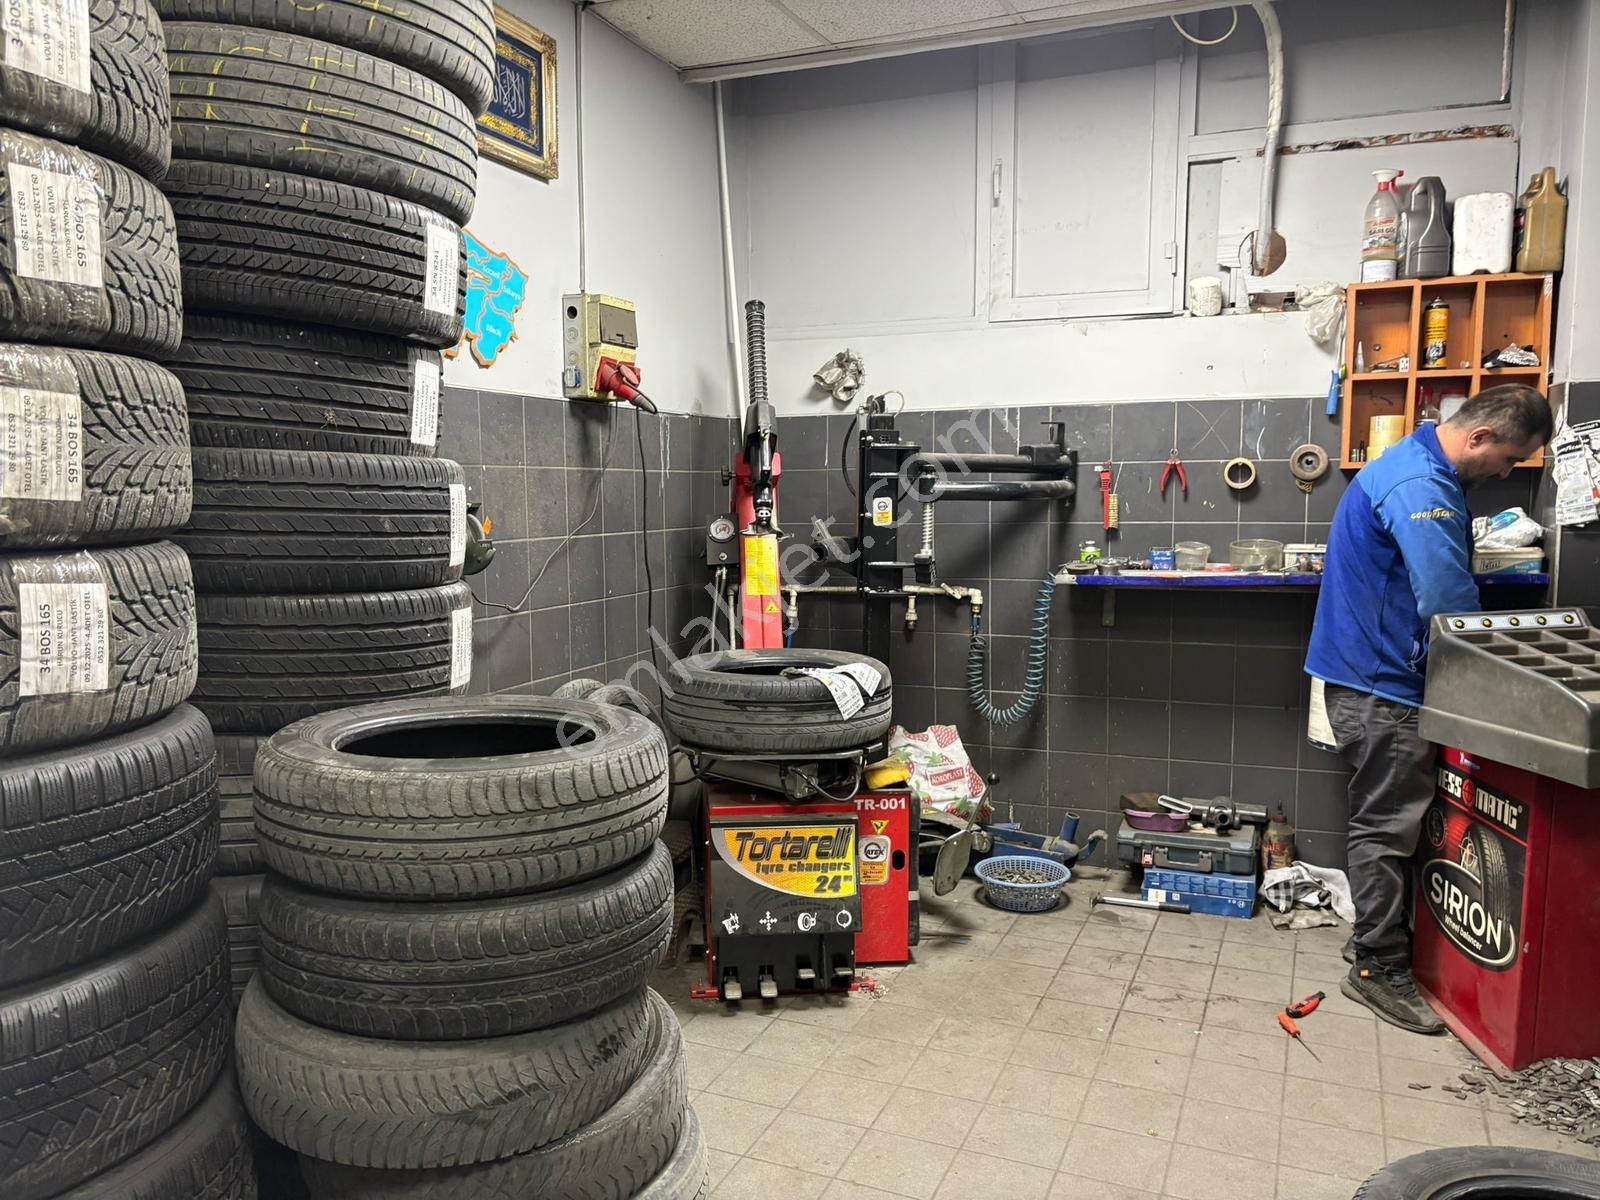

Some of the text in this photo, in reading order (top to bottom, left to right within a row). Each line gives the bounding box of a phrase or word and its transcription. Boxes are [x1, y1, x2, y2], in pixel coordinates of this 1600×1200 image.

[43, 33, 51, 61] VOLVO
[31, 174, 41, 218] 09.12.2025
[47, 185, 55, 213] VOLVO
[74, 214, 86, 241] BOS
[77, 244, 87, 267] 165
[8, 434, 16, 448] 321
[67, 413, 78, 483] 34 BOS 165
[39, 604, 51, 673] 34 BOS 165
[854, 798, 905, 810] TR-001
[736, 827, 852, 862] Tortarelli
[788, 861, 851, 873] changers
[1430, 872, 1502, 952] SIRION
[1459, 927, 1483, 951] balancer
